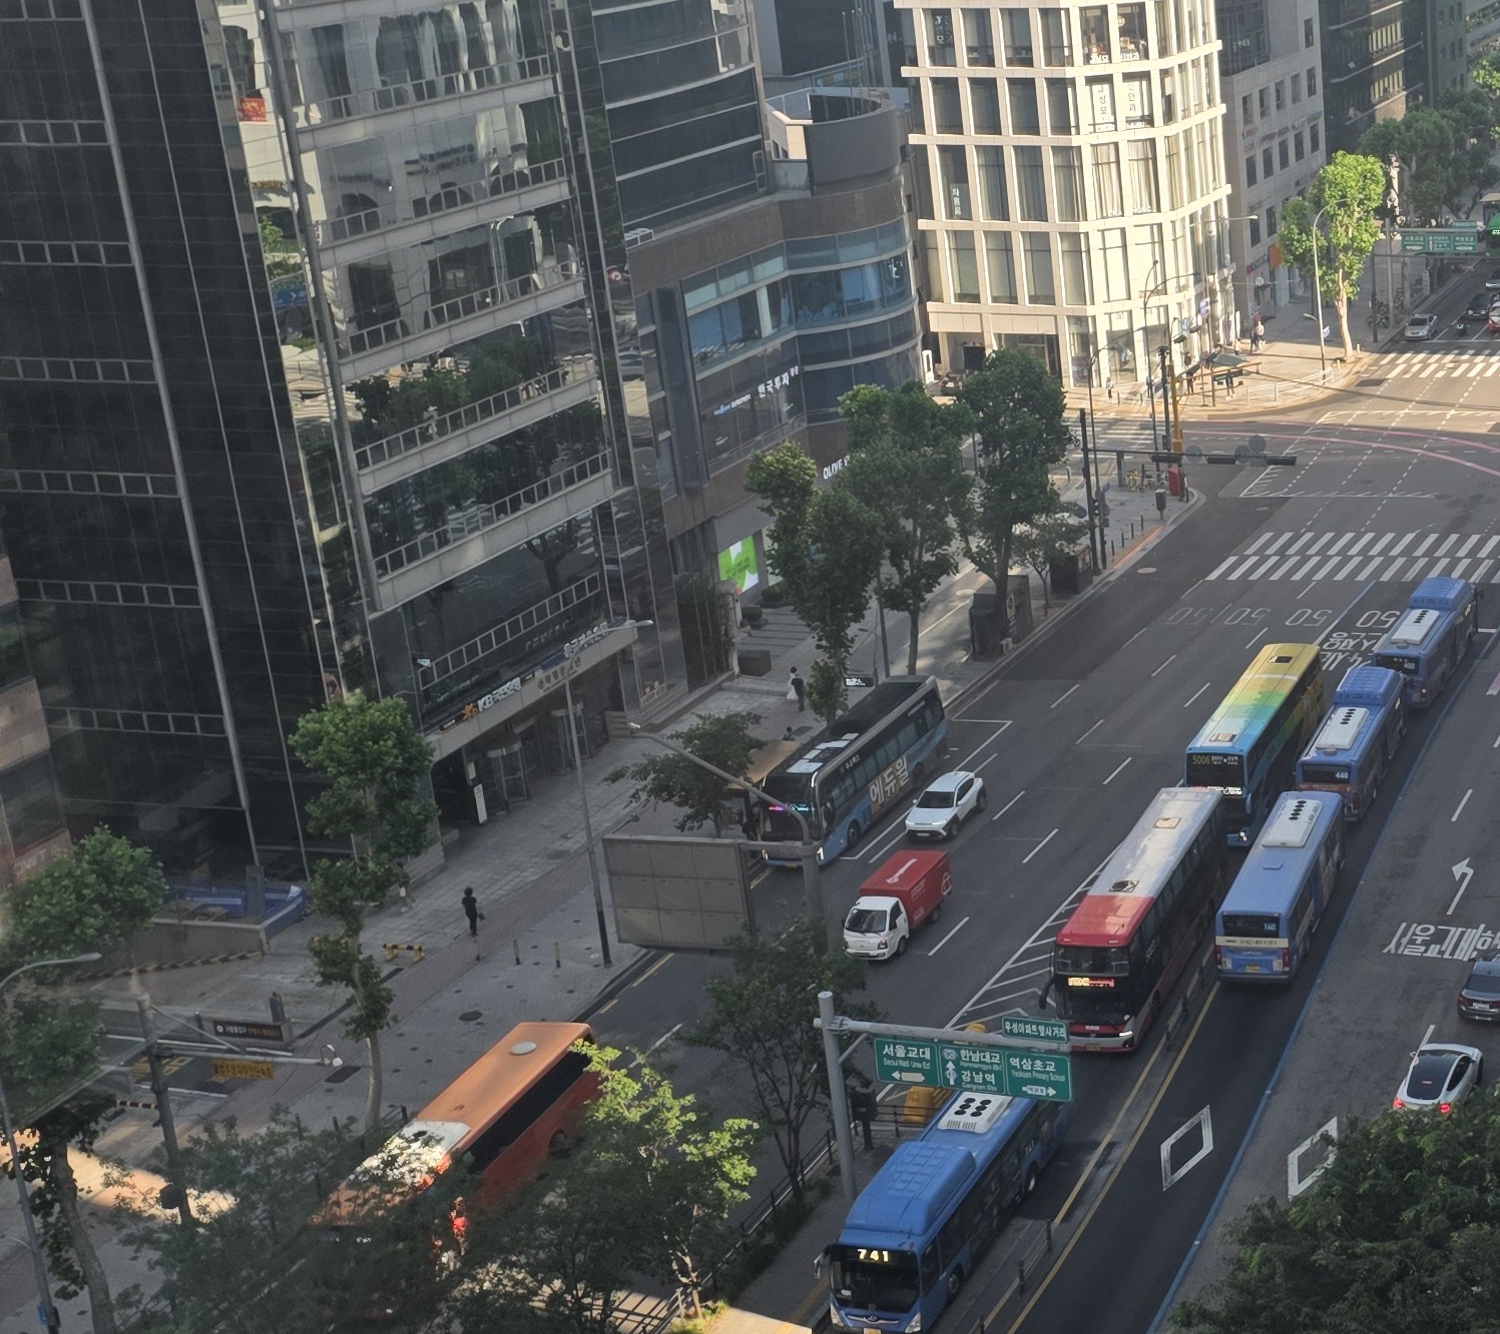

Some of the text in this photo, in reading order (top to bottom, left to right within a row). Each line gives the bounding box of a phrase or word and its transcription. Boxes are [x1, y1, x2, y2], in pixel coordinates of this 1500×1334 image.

[823, 457, 843, 480] OLIVE
[1285, 608, 1332, 627] 50
[1356, 610, 1400, 629] 50
[869, 754, 910, 806] 에듀윌
[1004, 1020, 1066, 1040] 우성아파트앞사거리
[882, 1044, 931, 1059] 서울교대
[960, 1049, 1001, 1064] 한남대교
[1009, 1057, 1056, 1072] 역삼초교
[961, 1070, 996, 1085] 강남역
[858, 1248, 890, 1262] 741
